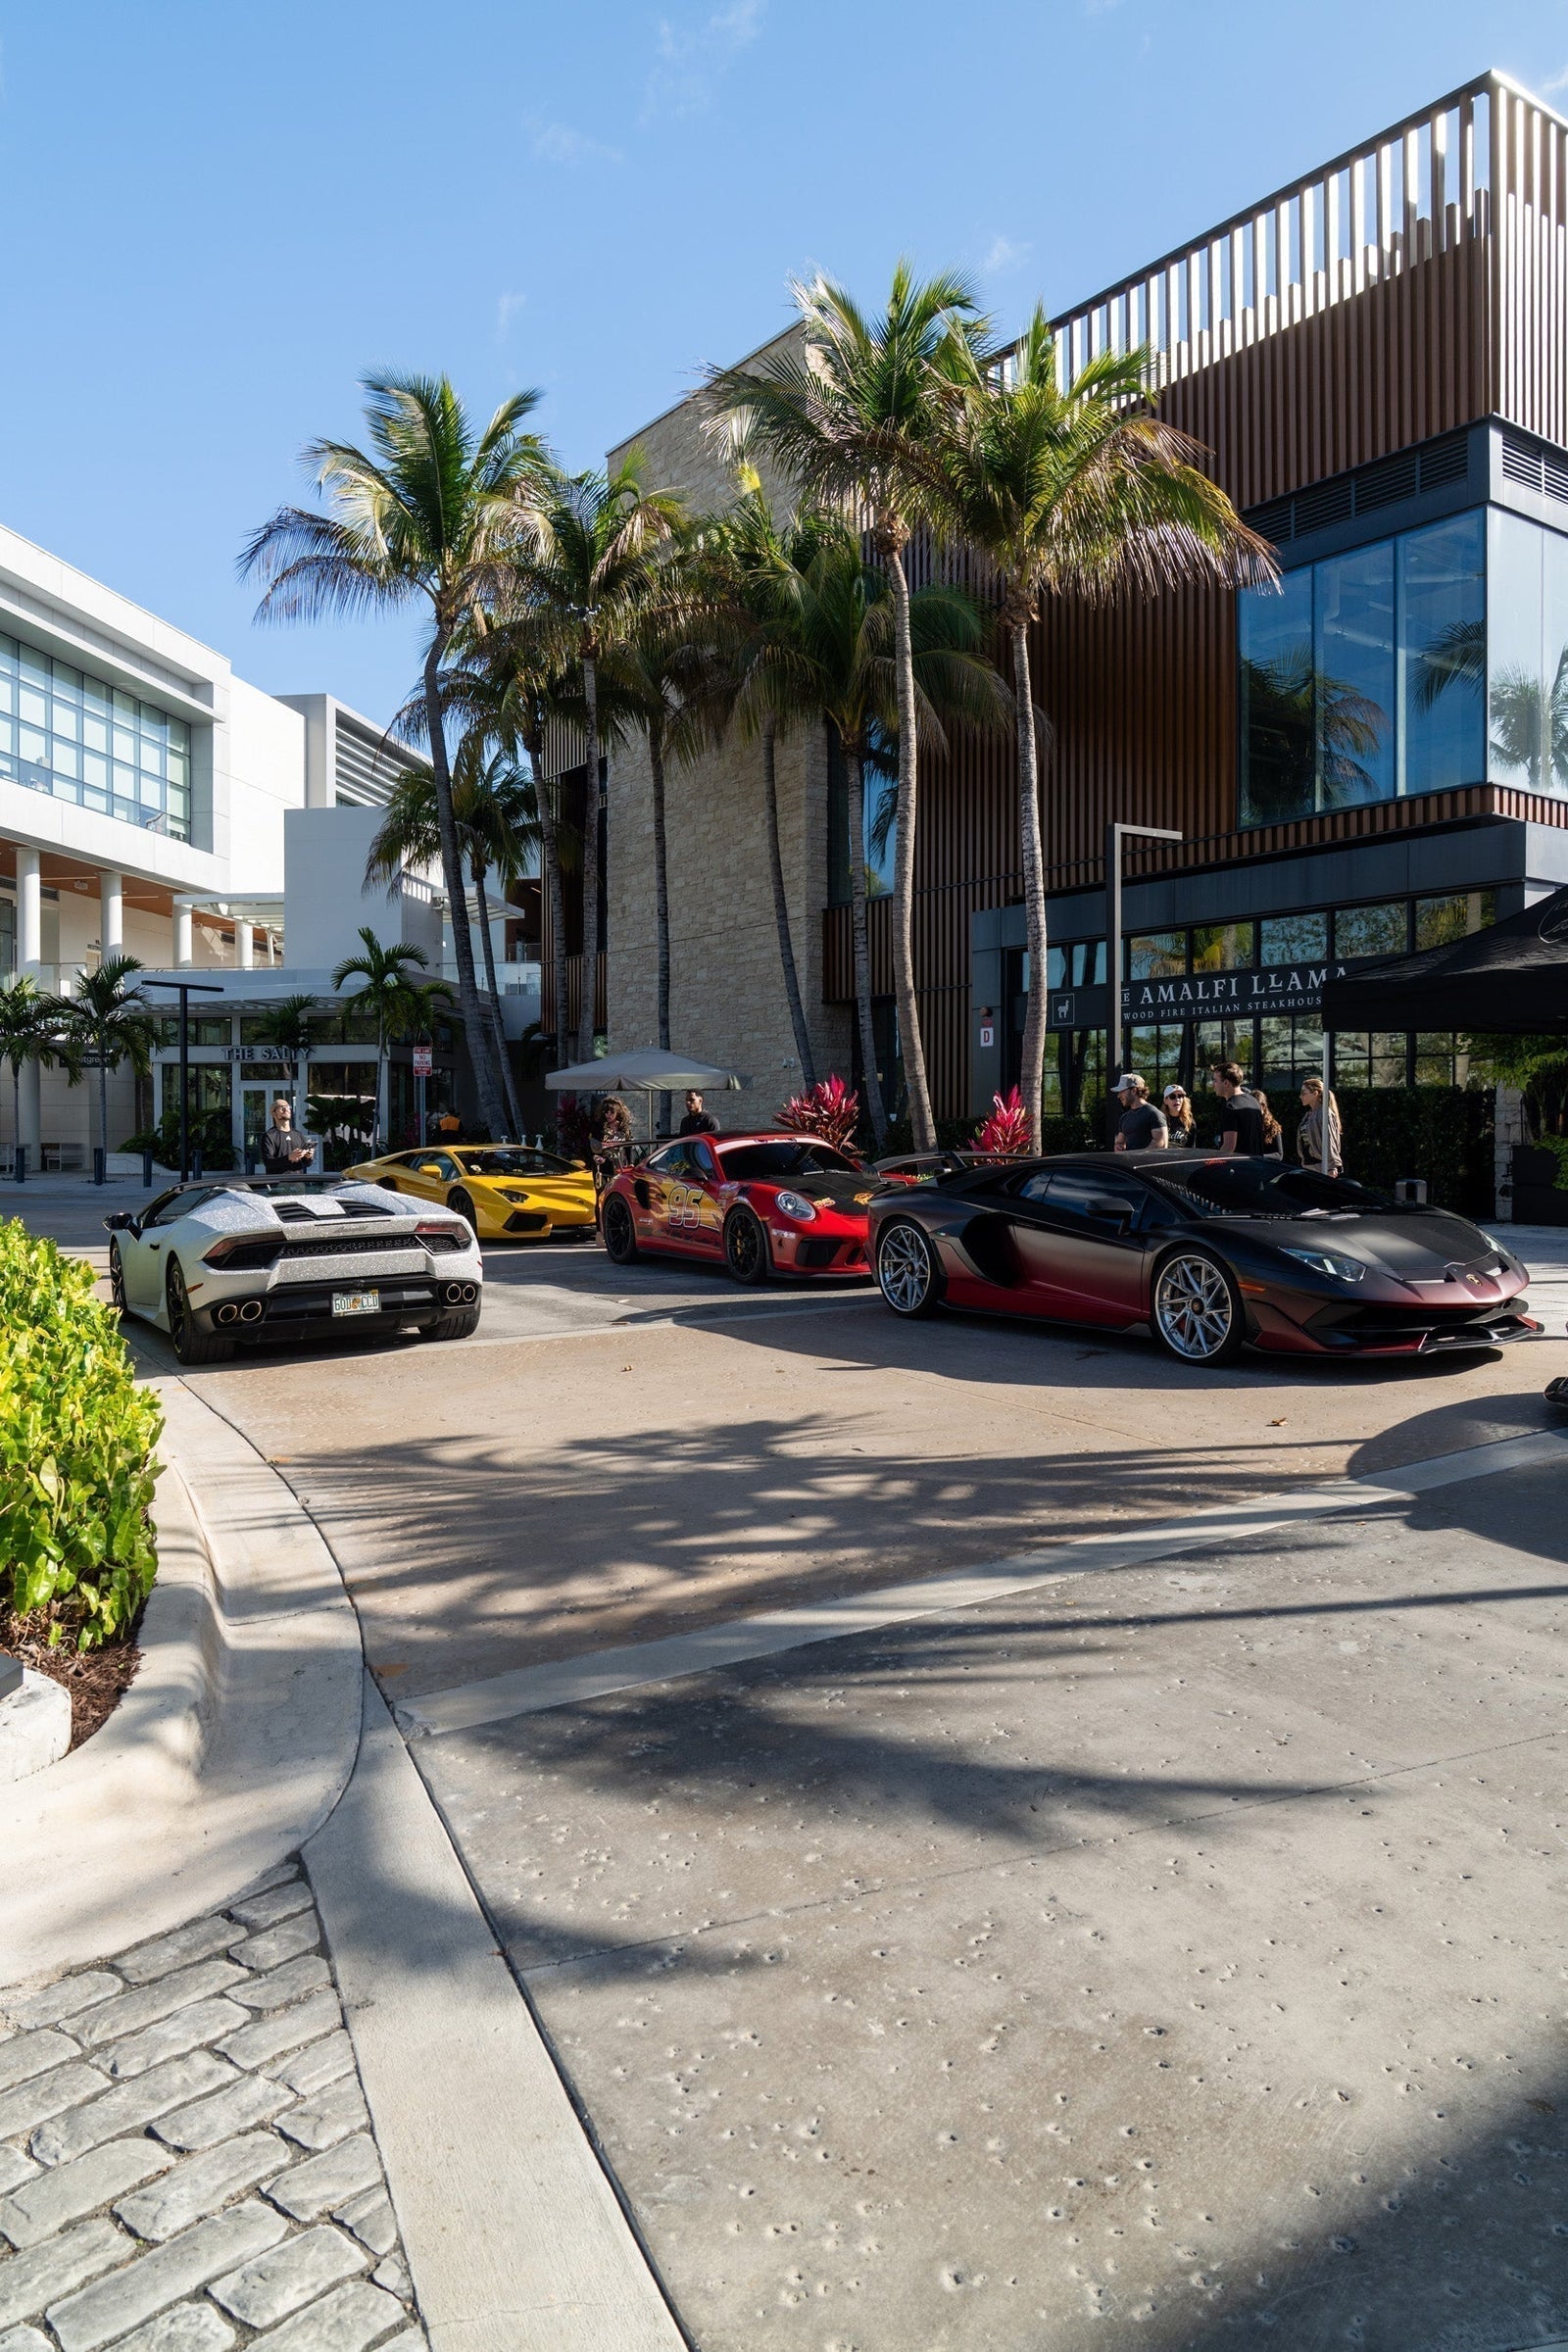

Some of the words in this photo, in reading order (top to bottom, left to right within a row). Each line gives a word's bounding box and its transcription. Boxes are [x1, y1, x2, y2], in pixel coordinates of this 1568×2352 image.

[1140, 978, 1239, 1004] AMALFI
[1123, 1010, 1154, 1020] WOOD
[1160, 1007, 1186, 1017] FIRE
[1192, 1003, 1241, 1015] ITALIAN
[1247, 996, 1322, 1010] STEAKHOUS
[983, 1030, 990, 1043] D
[222, 1047, 254, 1060] THE
[668, 1186, 705, 1230] 95
